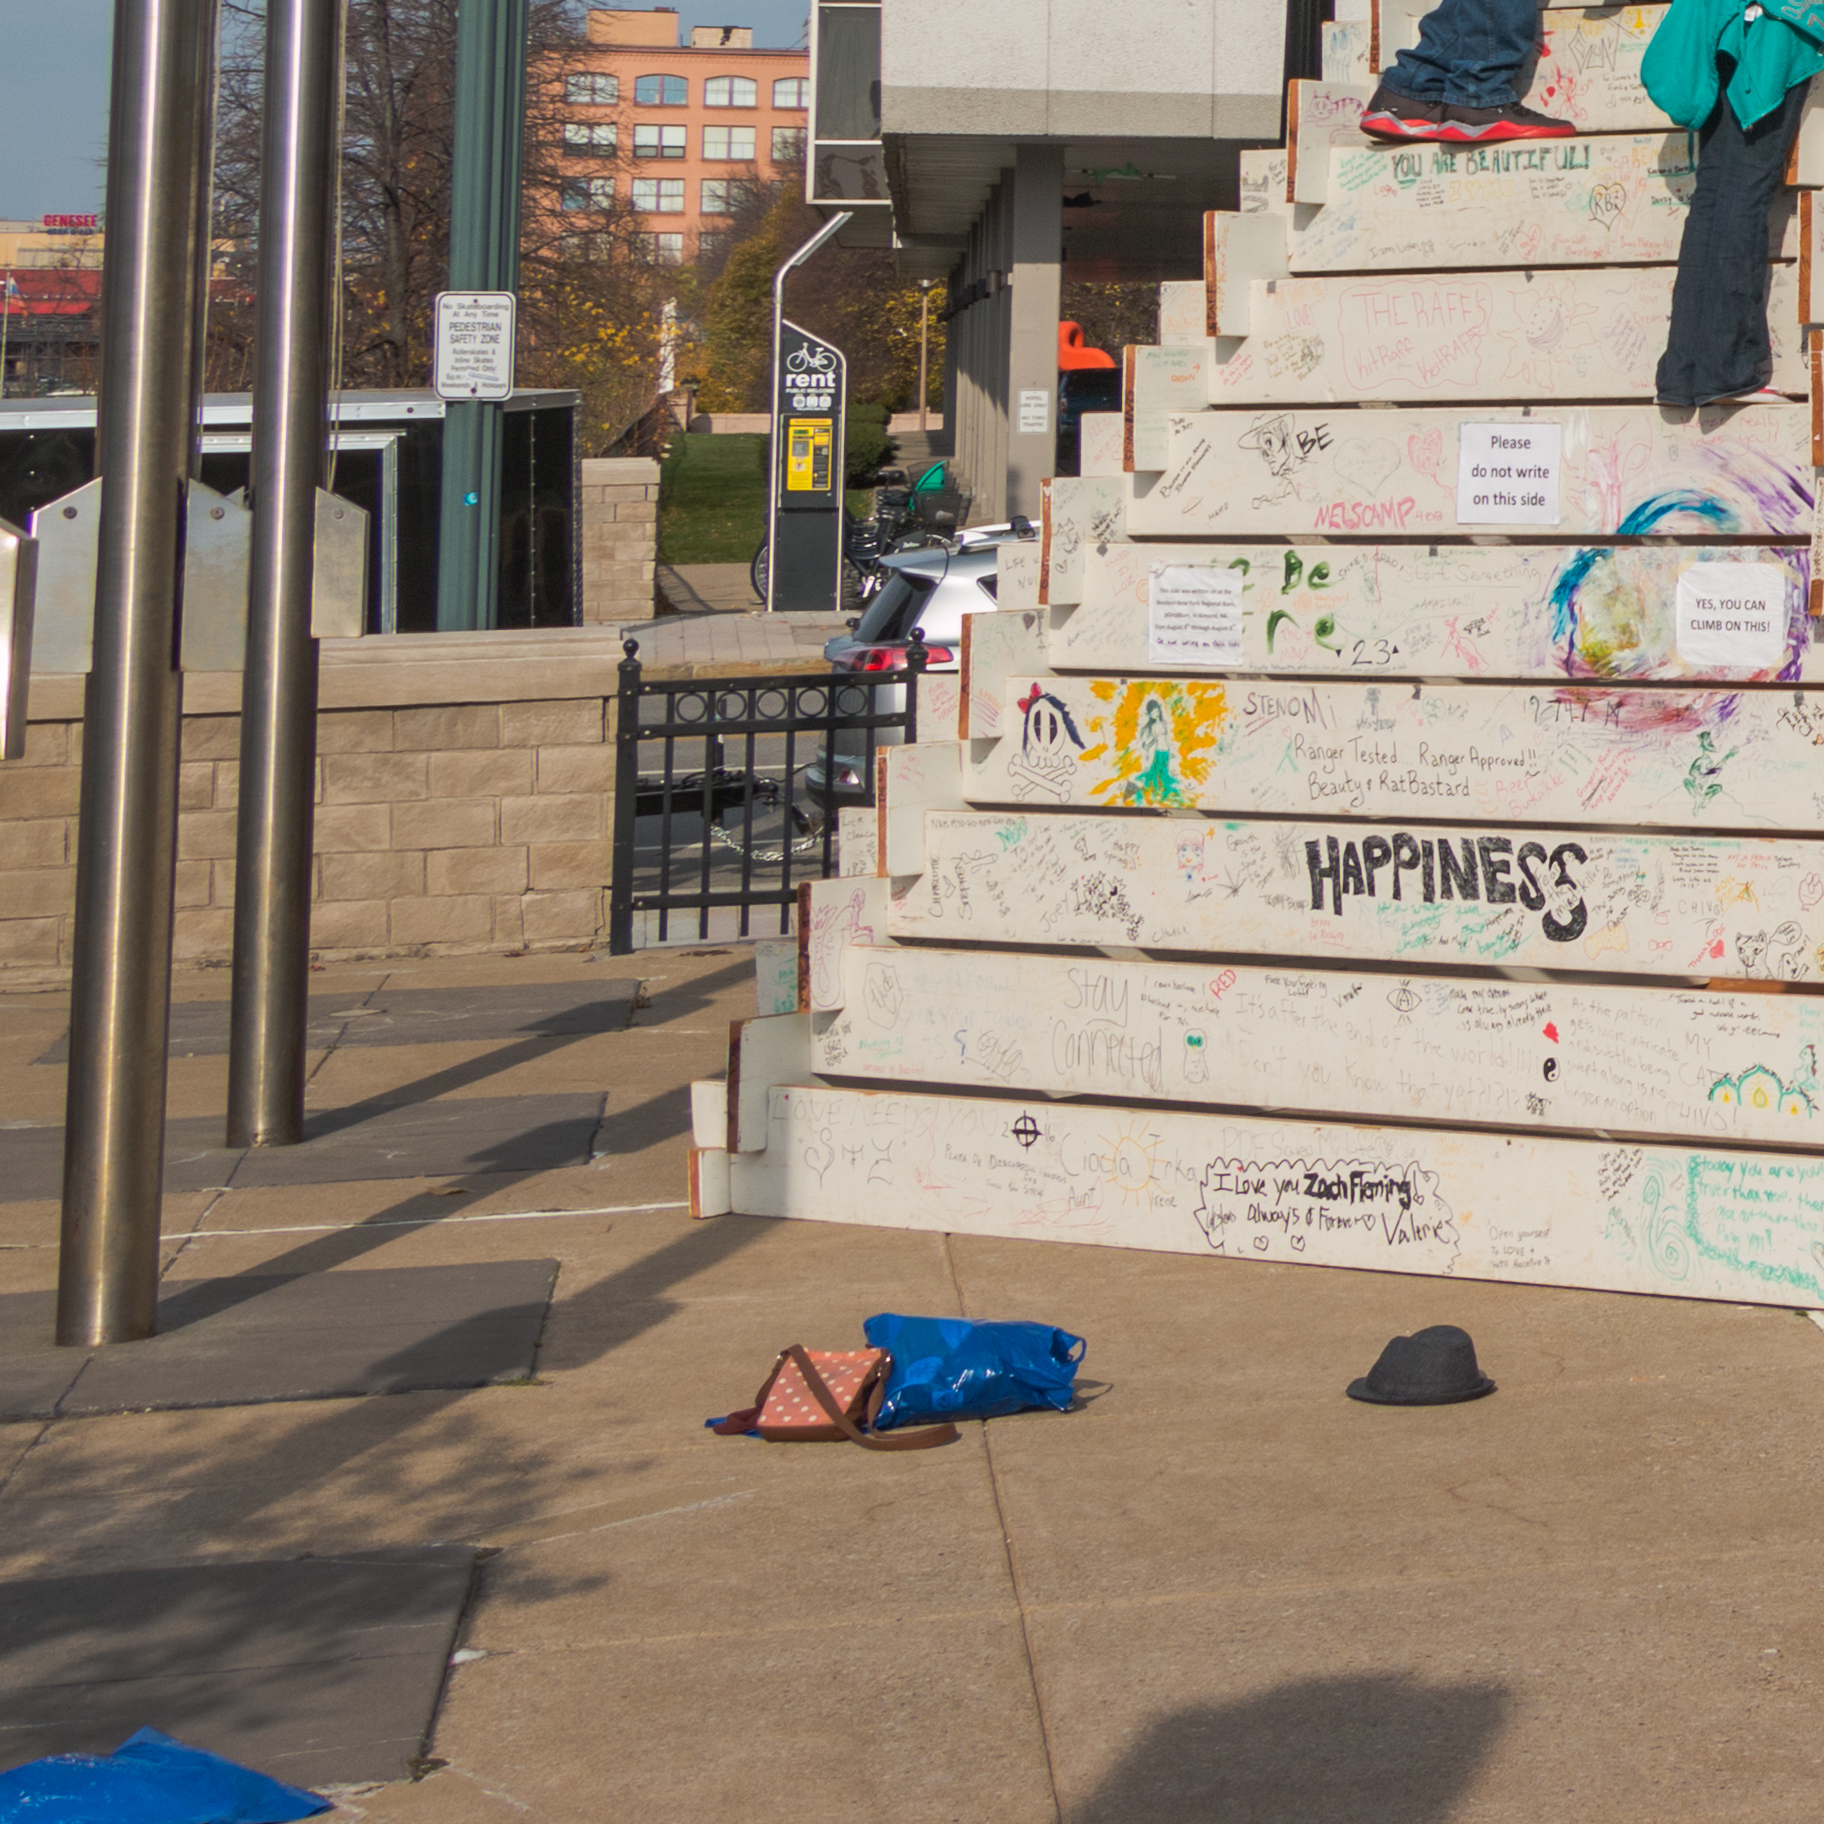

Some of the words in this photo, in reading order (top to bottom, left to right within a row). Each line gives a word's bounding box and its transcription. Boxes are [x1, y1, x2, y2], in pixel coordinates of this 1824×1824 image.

[1391, 151, 1423, 178] YOU
[1432, 148, 1458, 173] ARE
[1466, 144, 1590, 175] BEAUTIFUL!
[43, 214, 98, 227] GENESEE
[457, 303, 509, 311] Skateboarding
[1351, 291, 1408, 334] THE
[449, 322, 502, 331] PEDESTRIAN
[450, 334, 476, 344] SAFETY
[480, 334, 500, 344] ZONE
[786, 371, 836, 387] rent
[1295, 423, 1336, 457] BE
[1490, 435, 1531, 451] Please
[1471, 464, 1489, 479] do
[1491, 465, 1513, 479] not
[1516, 464, 1550, 479] write
[1473, 493, 1489, 506] on
[1492, 491, 1517, 506] this
[1520, 491, 1546, 507] side
[1281, 549, 1330, 595] Be
[1695, 598, 1717, 612] YES,
[1719, 599, 1742, 610] YOU
[1745, 600, 1766, 612] CAN
[1690, 619, 1722, 631] CLIMB
[1725, 621, 1742, 632] ON
[1744, 621, 1771, 633] THIS!
[1352, 639, 1391, 666] 23
[1294, 734, 1345, 774] Ranger
[1419, 743, 1465, 776] Ranger
[1308, 771, 1365, 808] Beauty
[1304, 832, 1589, 942] HAPPINESS
[1063, 967, 1130, 1027] Stay
[1209, 969, 1238, 999] RED
[1685, 1031, 1713, 1058] MY
[1234, 1175, 1268, 1197] Love
[1274, 1177, 1300, 1202] you
